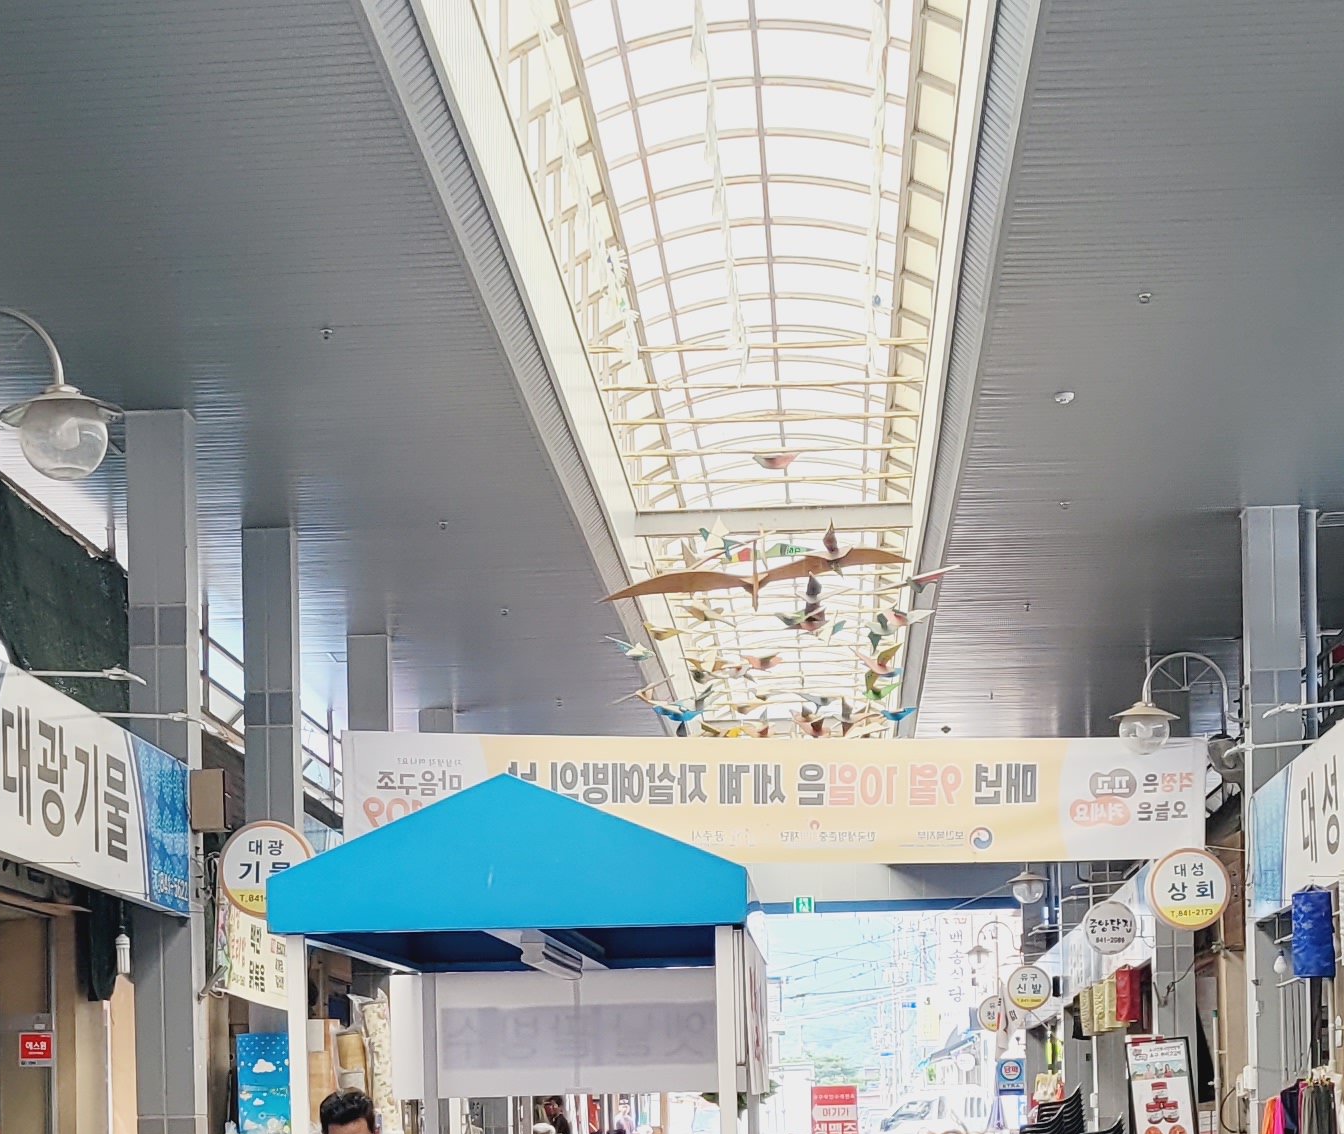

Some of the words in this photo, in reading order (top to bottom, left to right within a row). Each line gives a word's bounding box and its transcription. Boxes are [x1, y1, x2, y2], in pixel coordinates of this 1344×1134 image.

[1, 704, 130, 864] 대광기물
[248, 838, 285, 857] 대광
[1173, 862, 1205, 878] 대성
[1167, 880, 1215, 902] 상회
[1088, 917, 1134, 935] 중앙닭집
[1020, 972, 1039, 982] 유구
[1016, 983, 1043, 995] 신발
[25, 1041, 47, 1051] 에스원
[822, 1107, 850, 1117] 여기가
